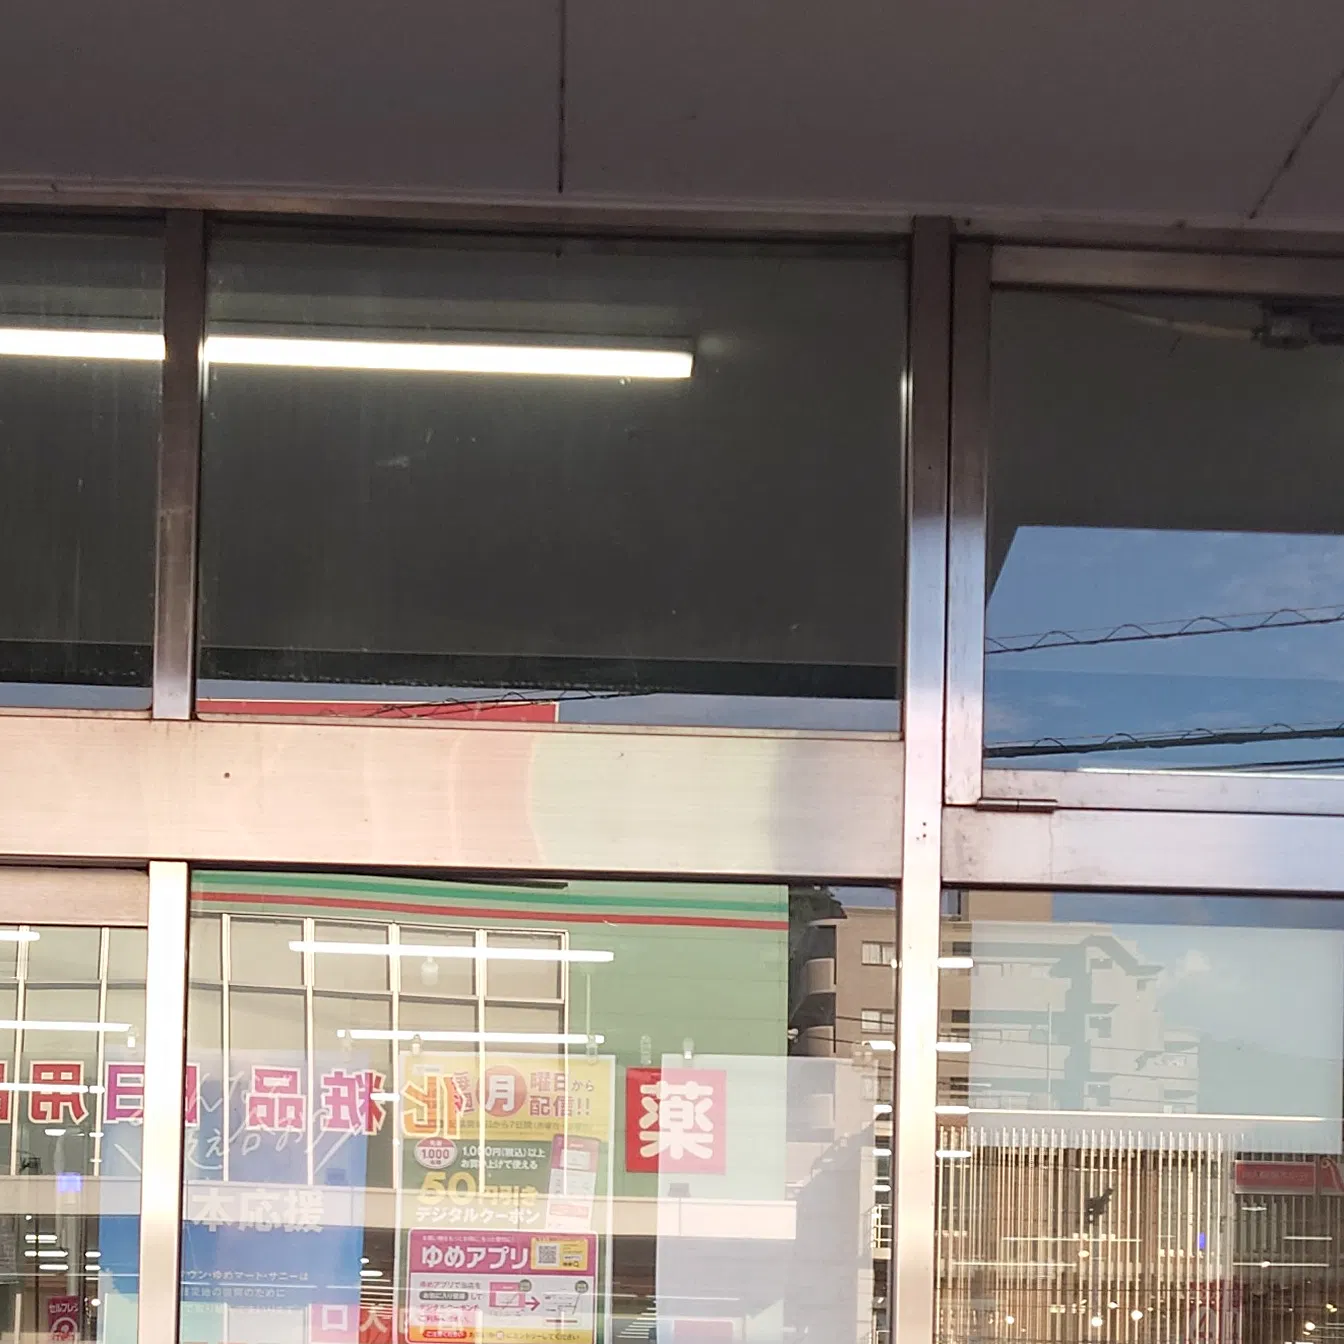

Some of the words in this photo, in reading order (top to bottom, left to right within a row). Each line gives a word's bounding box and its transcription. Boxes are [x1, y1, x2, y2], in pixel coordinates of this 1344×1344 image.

[486, 1075, 516, 1112] 月
[191, 1187, 325, 1233] 本応援
[416, 1206, 541, 1225] デジタルクーポン
[421, 1245, 529, 1269] ゆめアプリ
